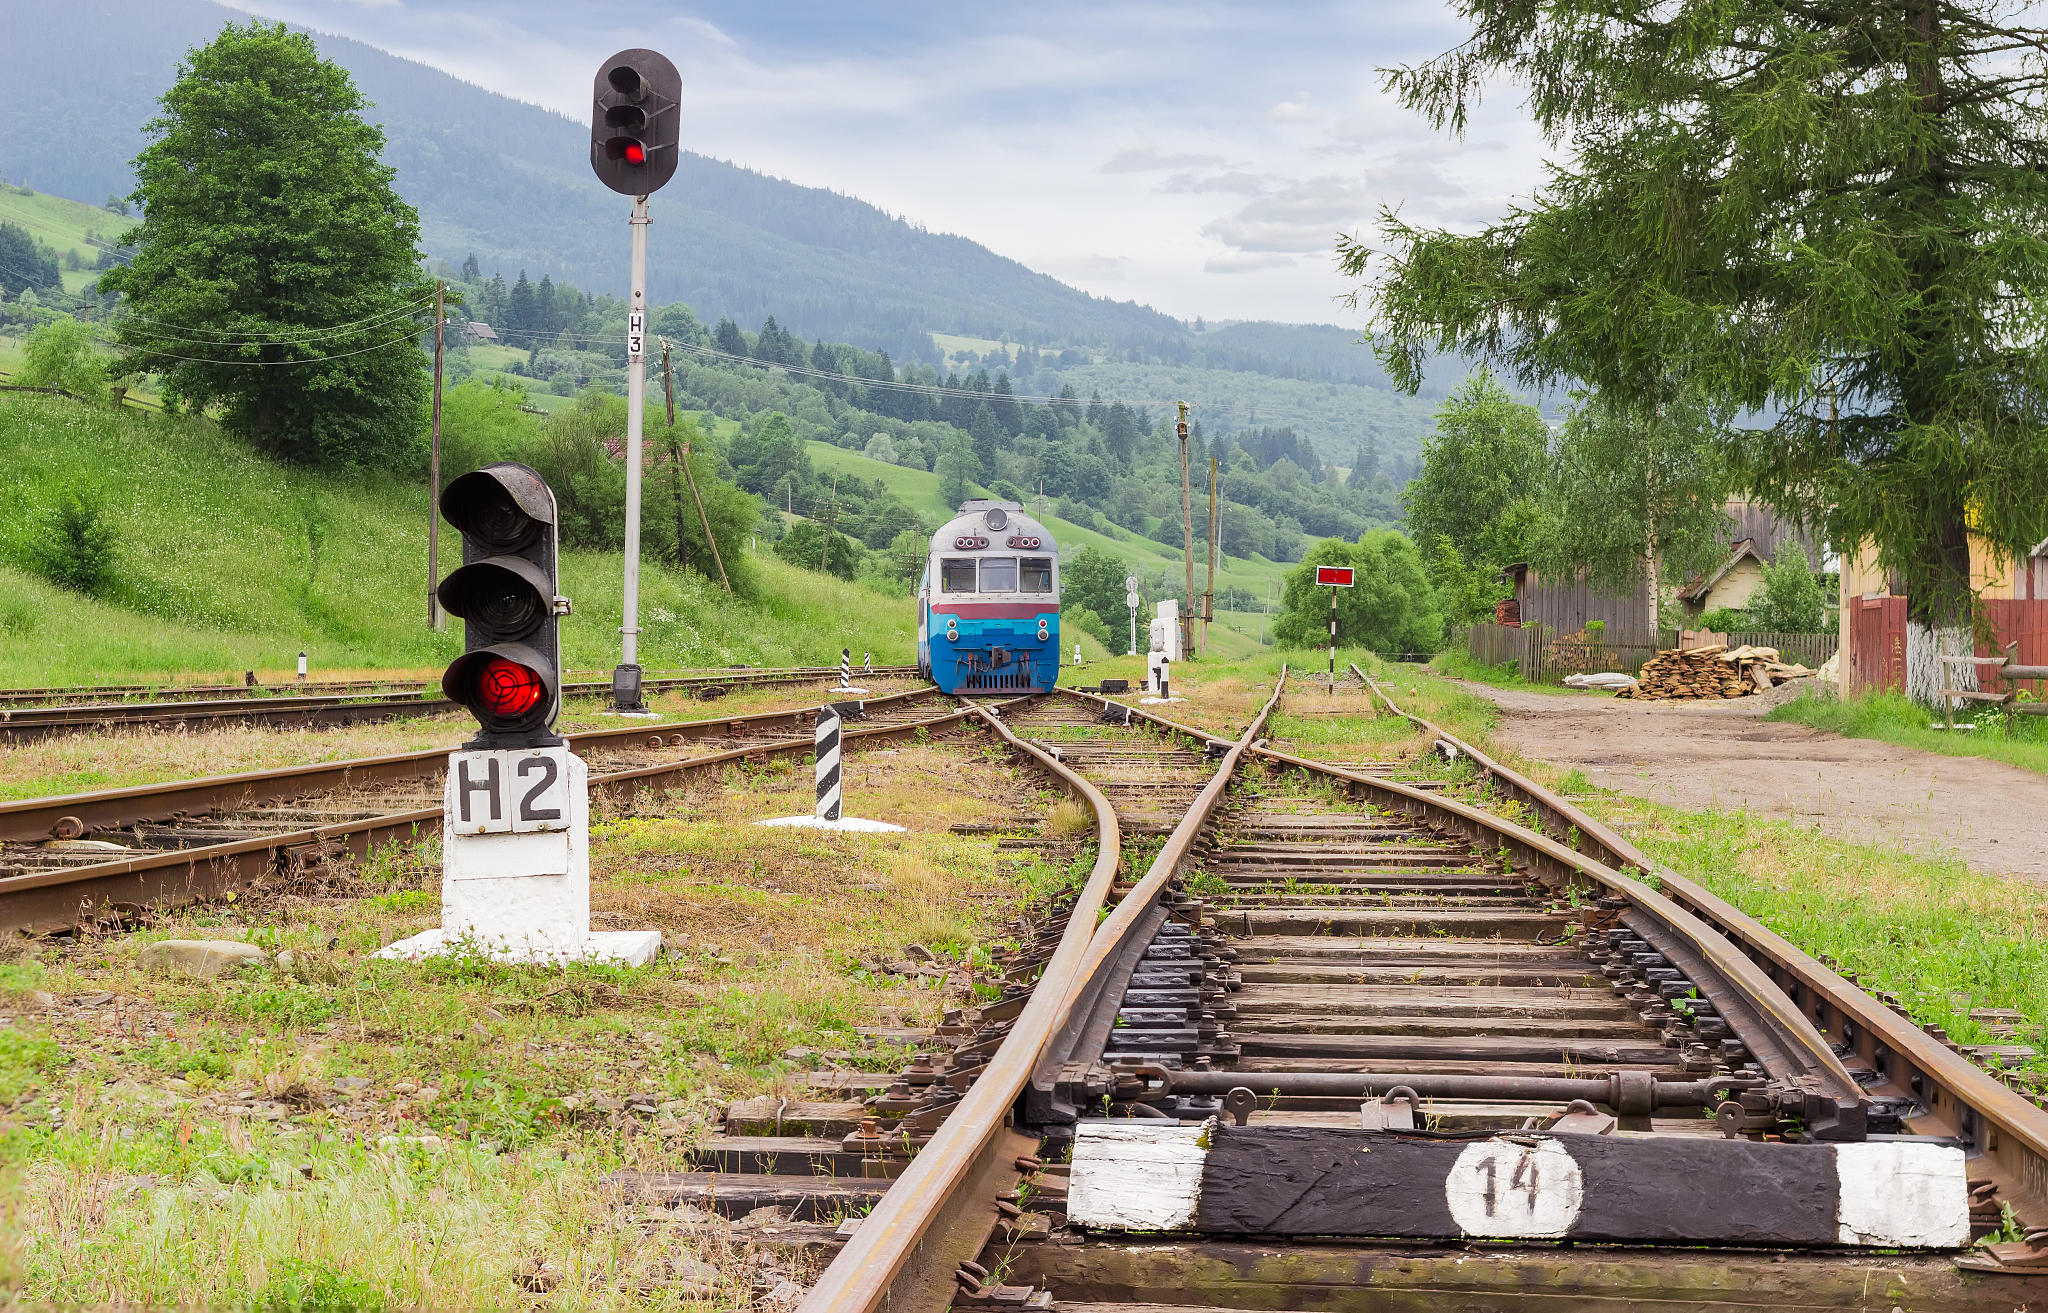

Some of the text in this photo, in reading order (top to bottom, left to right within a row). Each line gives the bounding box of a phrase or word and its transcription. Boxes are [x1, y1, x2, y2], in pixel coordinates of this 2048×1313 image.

[630, 315, 642, 353] H3
[458, 756, 561, 822] H2
[1475, 1150, 1540, 1218] 14
